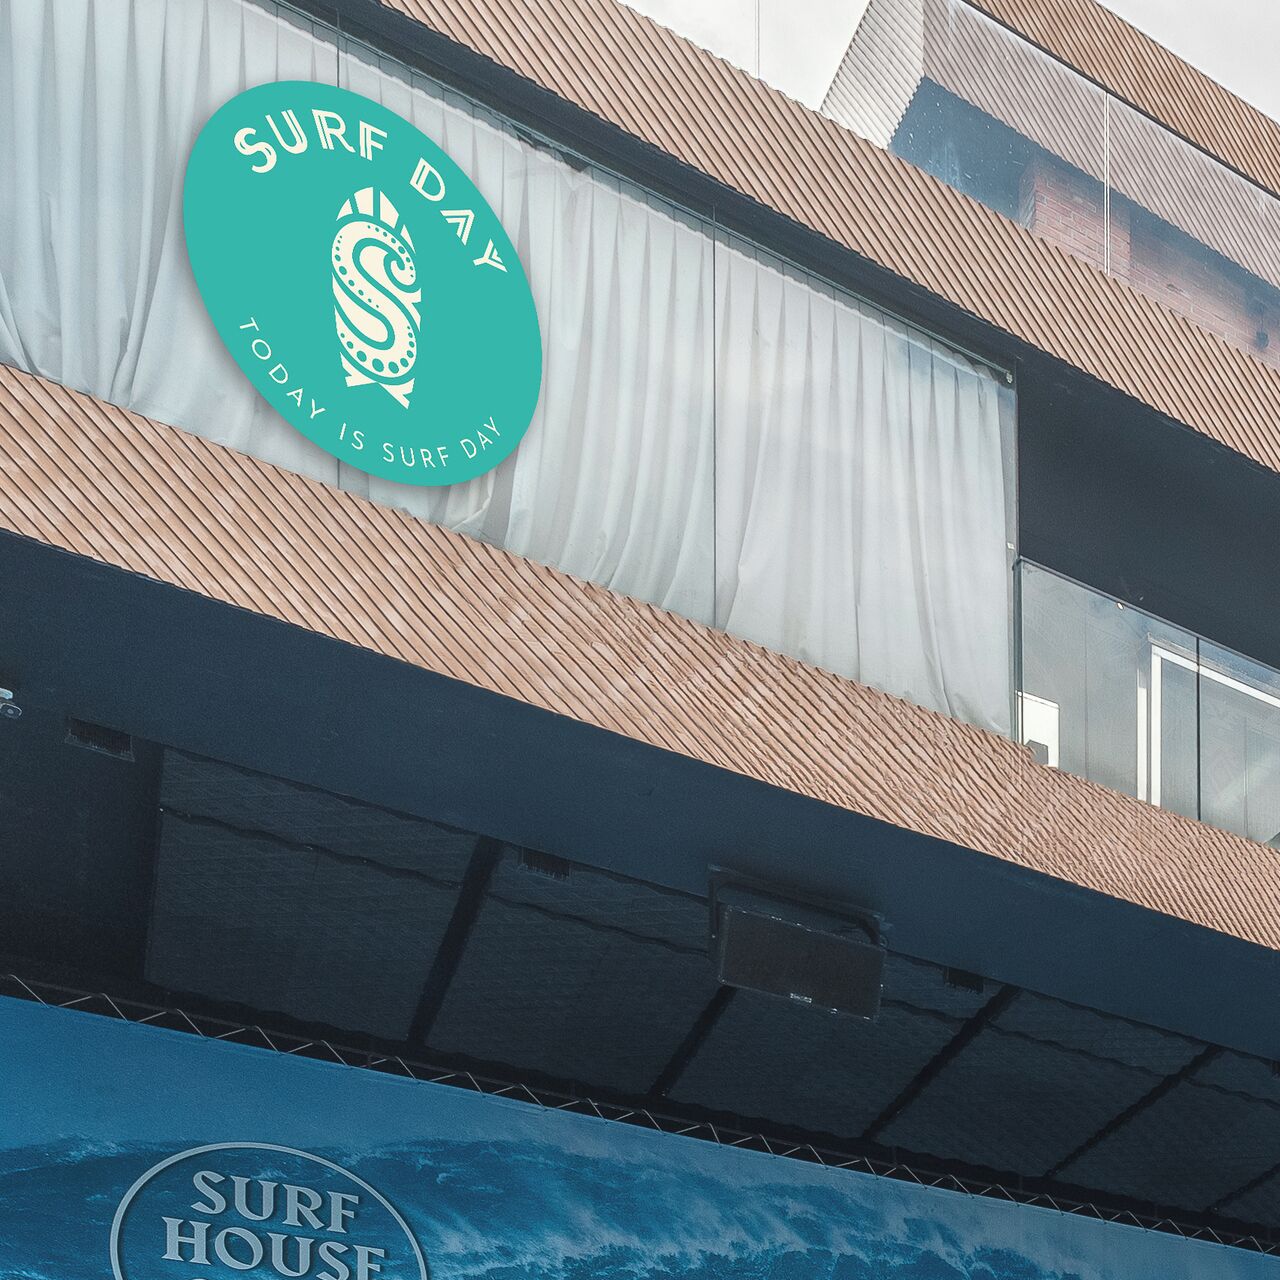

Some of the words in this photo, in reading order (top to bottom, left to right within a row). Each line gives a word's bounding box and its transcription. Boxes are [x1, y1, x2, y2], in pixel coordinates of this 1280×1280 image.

[234, 109, 388, 174] SURF
[409, 158, 507, 274] DAY
[239, 317, 326, 420] TODAY
[338, 422, 364, 451] IS
[382, 441, 450, 469] SURF
[459, 416, 502, 460] DAY
[191, 1170, 359, 1233] SURF
